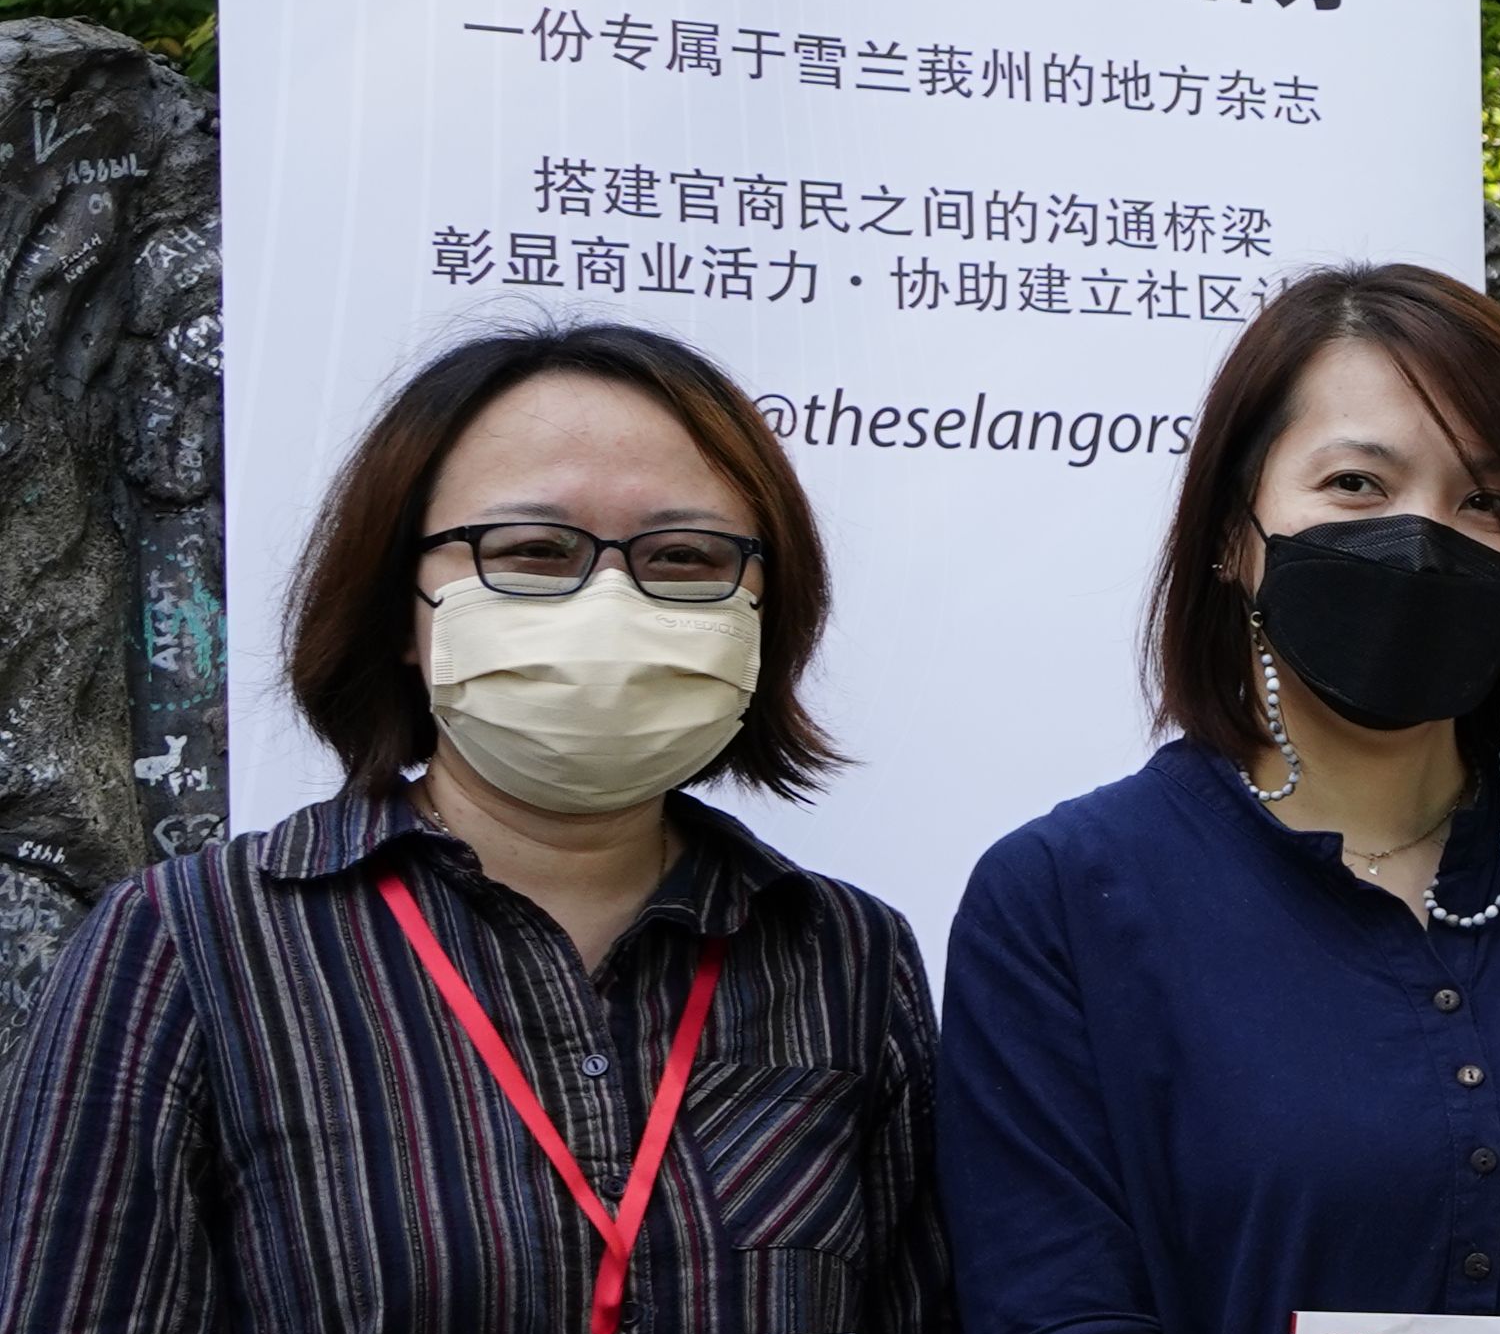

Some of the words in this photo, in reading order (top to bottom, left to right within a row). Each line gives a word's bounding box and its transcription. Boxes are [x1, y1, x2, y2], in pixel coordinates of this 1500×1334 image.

[463, 6, 1323, 126] 一份专属于雪兰莪州的地方杂志
[534, 154, 1272, 258] 搭建官商民之间的沟通桥梁
